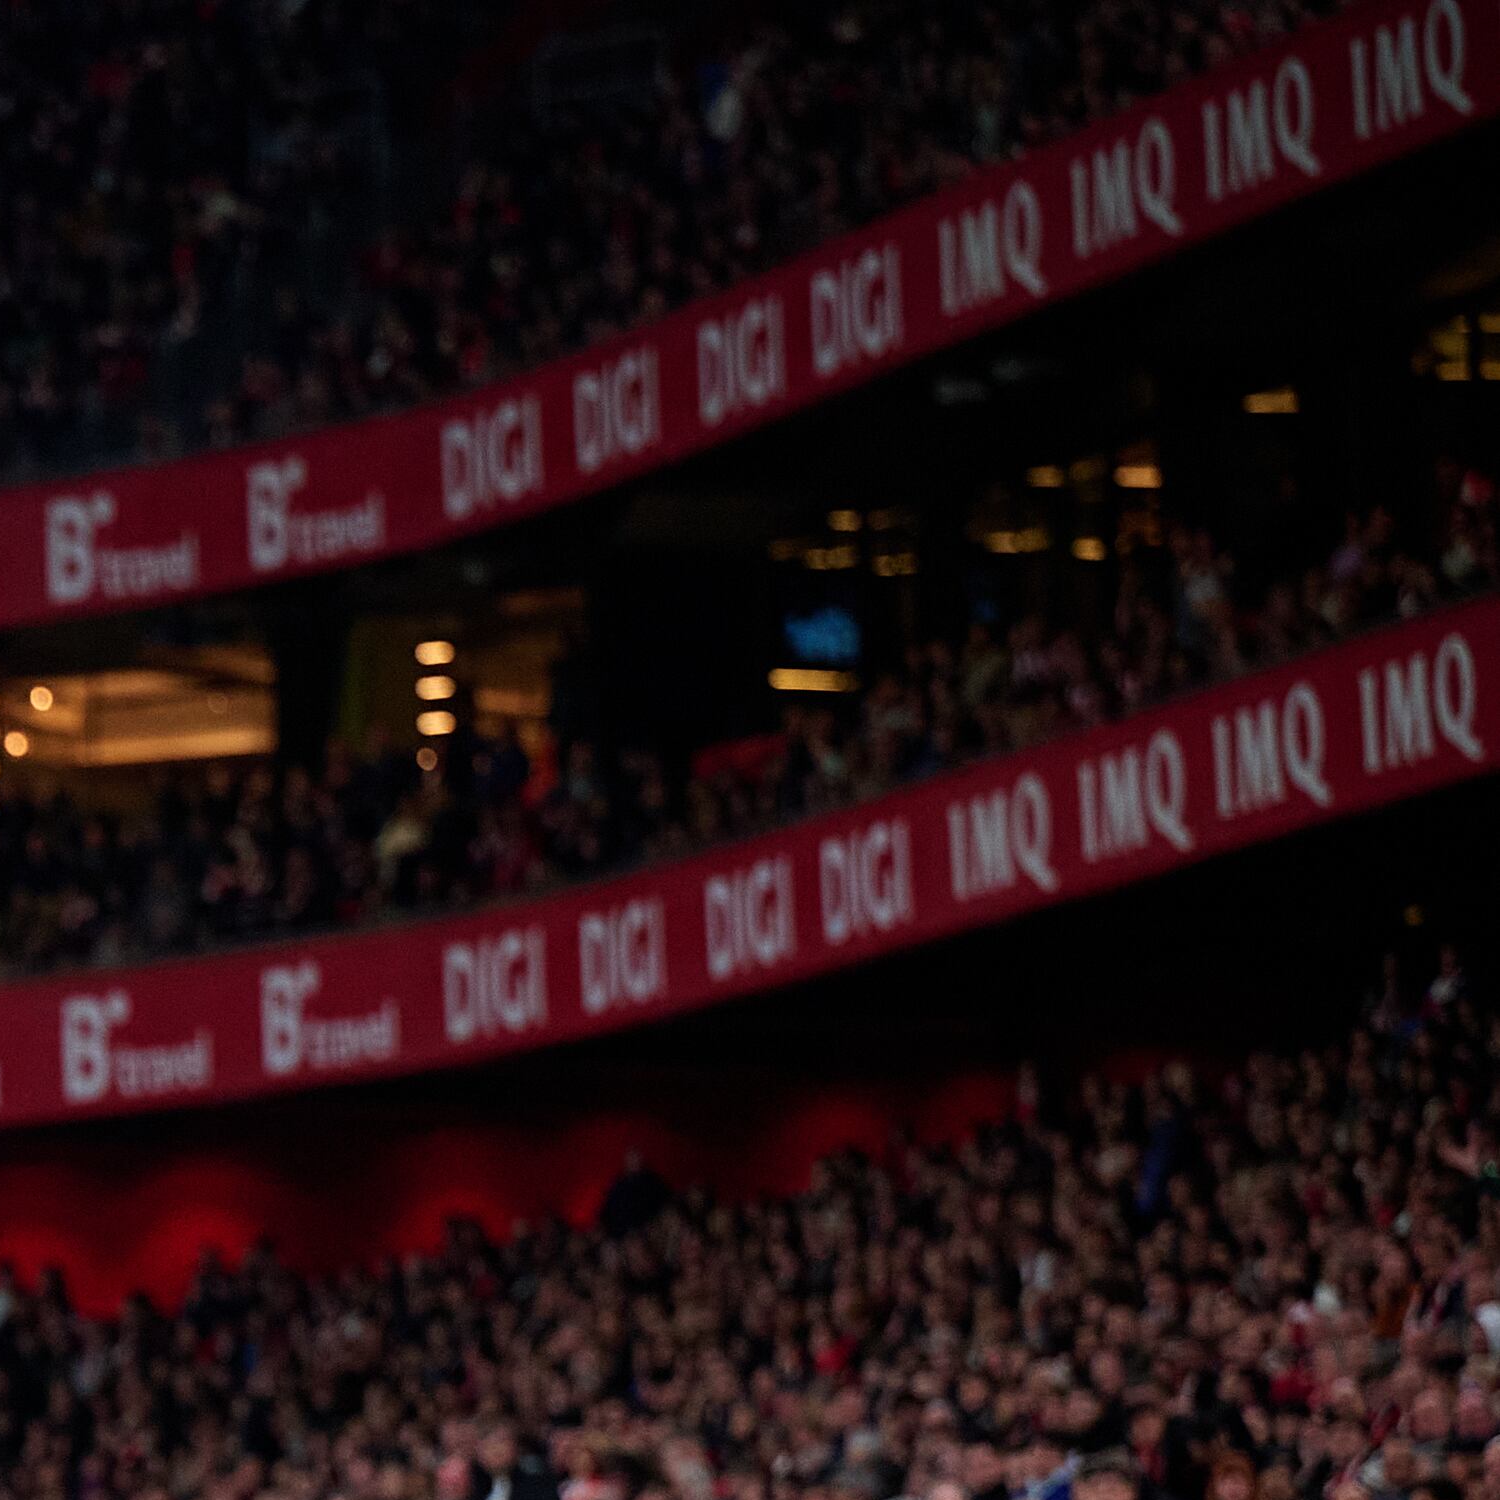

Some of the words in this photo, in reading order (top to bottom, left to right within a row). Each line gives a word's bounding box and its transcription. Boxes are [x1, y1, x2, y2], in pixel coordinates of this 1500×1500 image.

[1202, 58, 1321, 200] IMQ
[1349, 0, 1474, 139] IMQ
[938, 182, 1046, 314] IMQ
[1069, 119, 1183, 257] IMQ
[696, 299, 785, 425] DIGI
[810, 247, 902, 376] DIGI
[440, 398, 543, 520] DIGI
[573, 349, 659, 473] DIGI
[1211, 683, 1331, 818] IMQ
[1358, 634, 1483, 773] IMQ
[947, 774, 1057, 899] IMQ
[1077, 730, 1193, 861] IMQ
[704, 860, 795, 980] DIGI
[819, 822, 912, 944] DIGI
[443, 931, 547, 1043] DIGI
[578, 901, 665, 1014] DIGI
